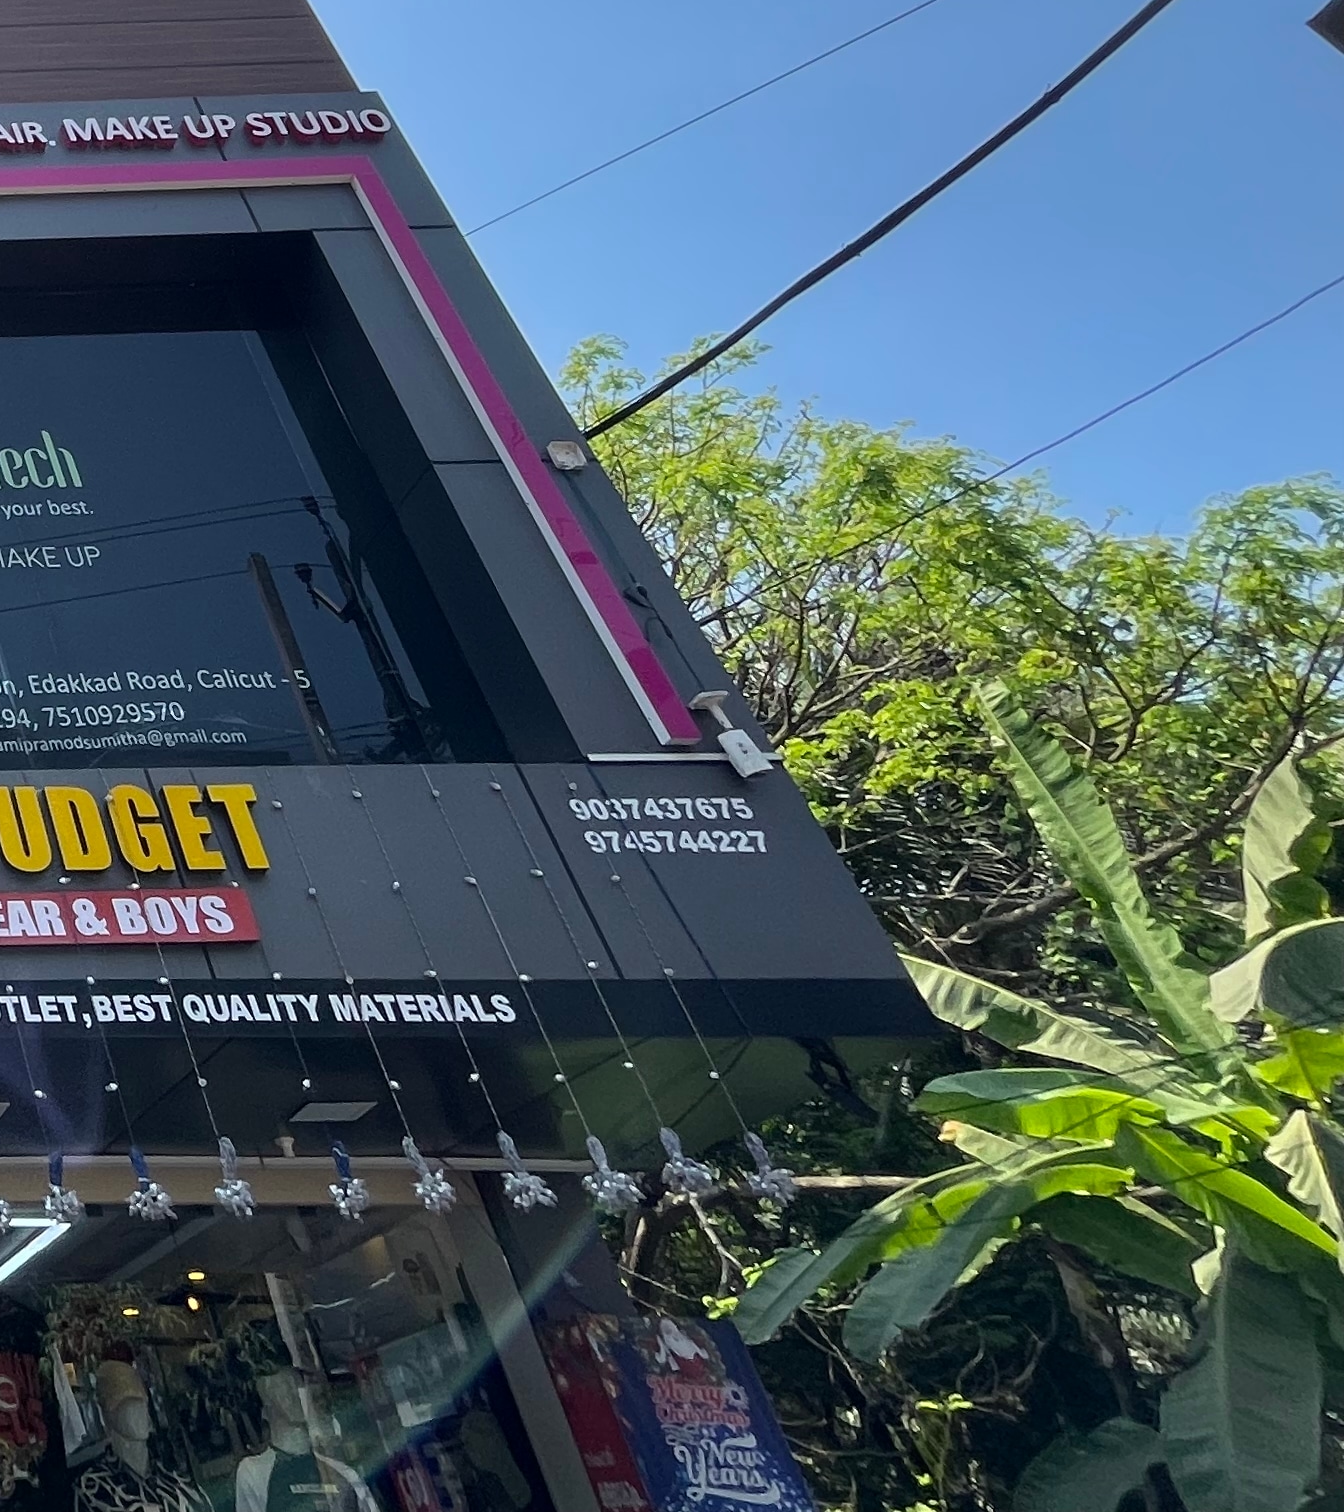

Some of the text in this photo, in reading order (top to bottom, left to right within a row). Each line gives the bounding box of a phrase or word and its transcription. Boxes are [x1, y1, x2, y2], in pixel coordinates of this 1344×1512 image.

[62, 115, 179, 145] MAKE
[183, 113, 236, 140] UP
[244, 107, 392, 138] STUDIO
[0, 502, 42, 520] your
[48, 498, 94, 516] best.
[67, 545, 101, 568] UP
[27, 671, 122, 695] Edakkad
[126, 669, 193, 693] Road,
[197, 668, 276, 690] Calicut
[293, 669, 311, 690] 5
[41, 701, 185, 728] 7510929570
[568, 797, 755, 820] 9037437675
[583, 829, 768, 854] 9745744227
[71, 896, 111, 936] &
[112, 895, 235, 936] BOYS
[183, 993, 321, 1024] QUALITY
[328, 994, 516, 1024] MATERIALS
[646, 1375, 729, 1410] Merry
[700, 1433, 758, 1467] New
